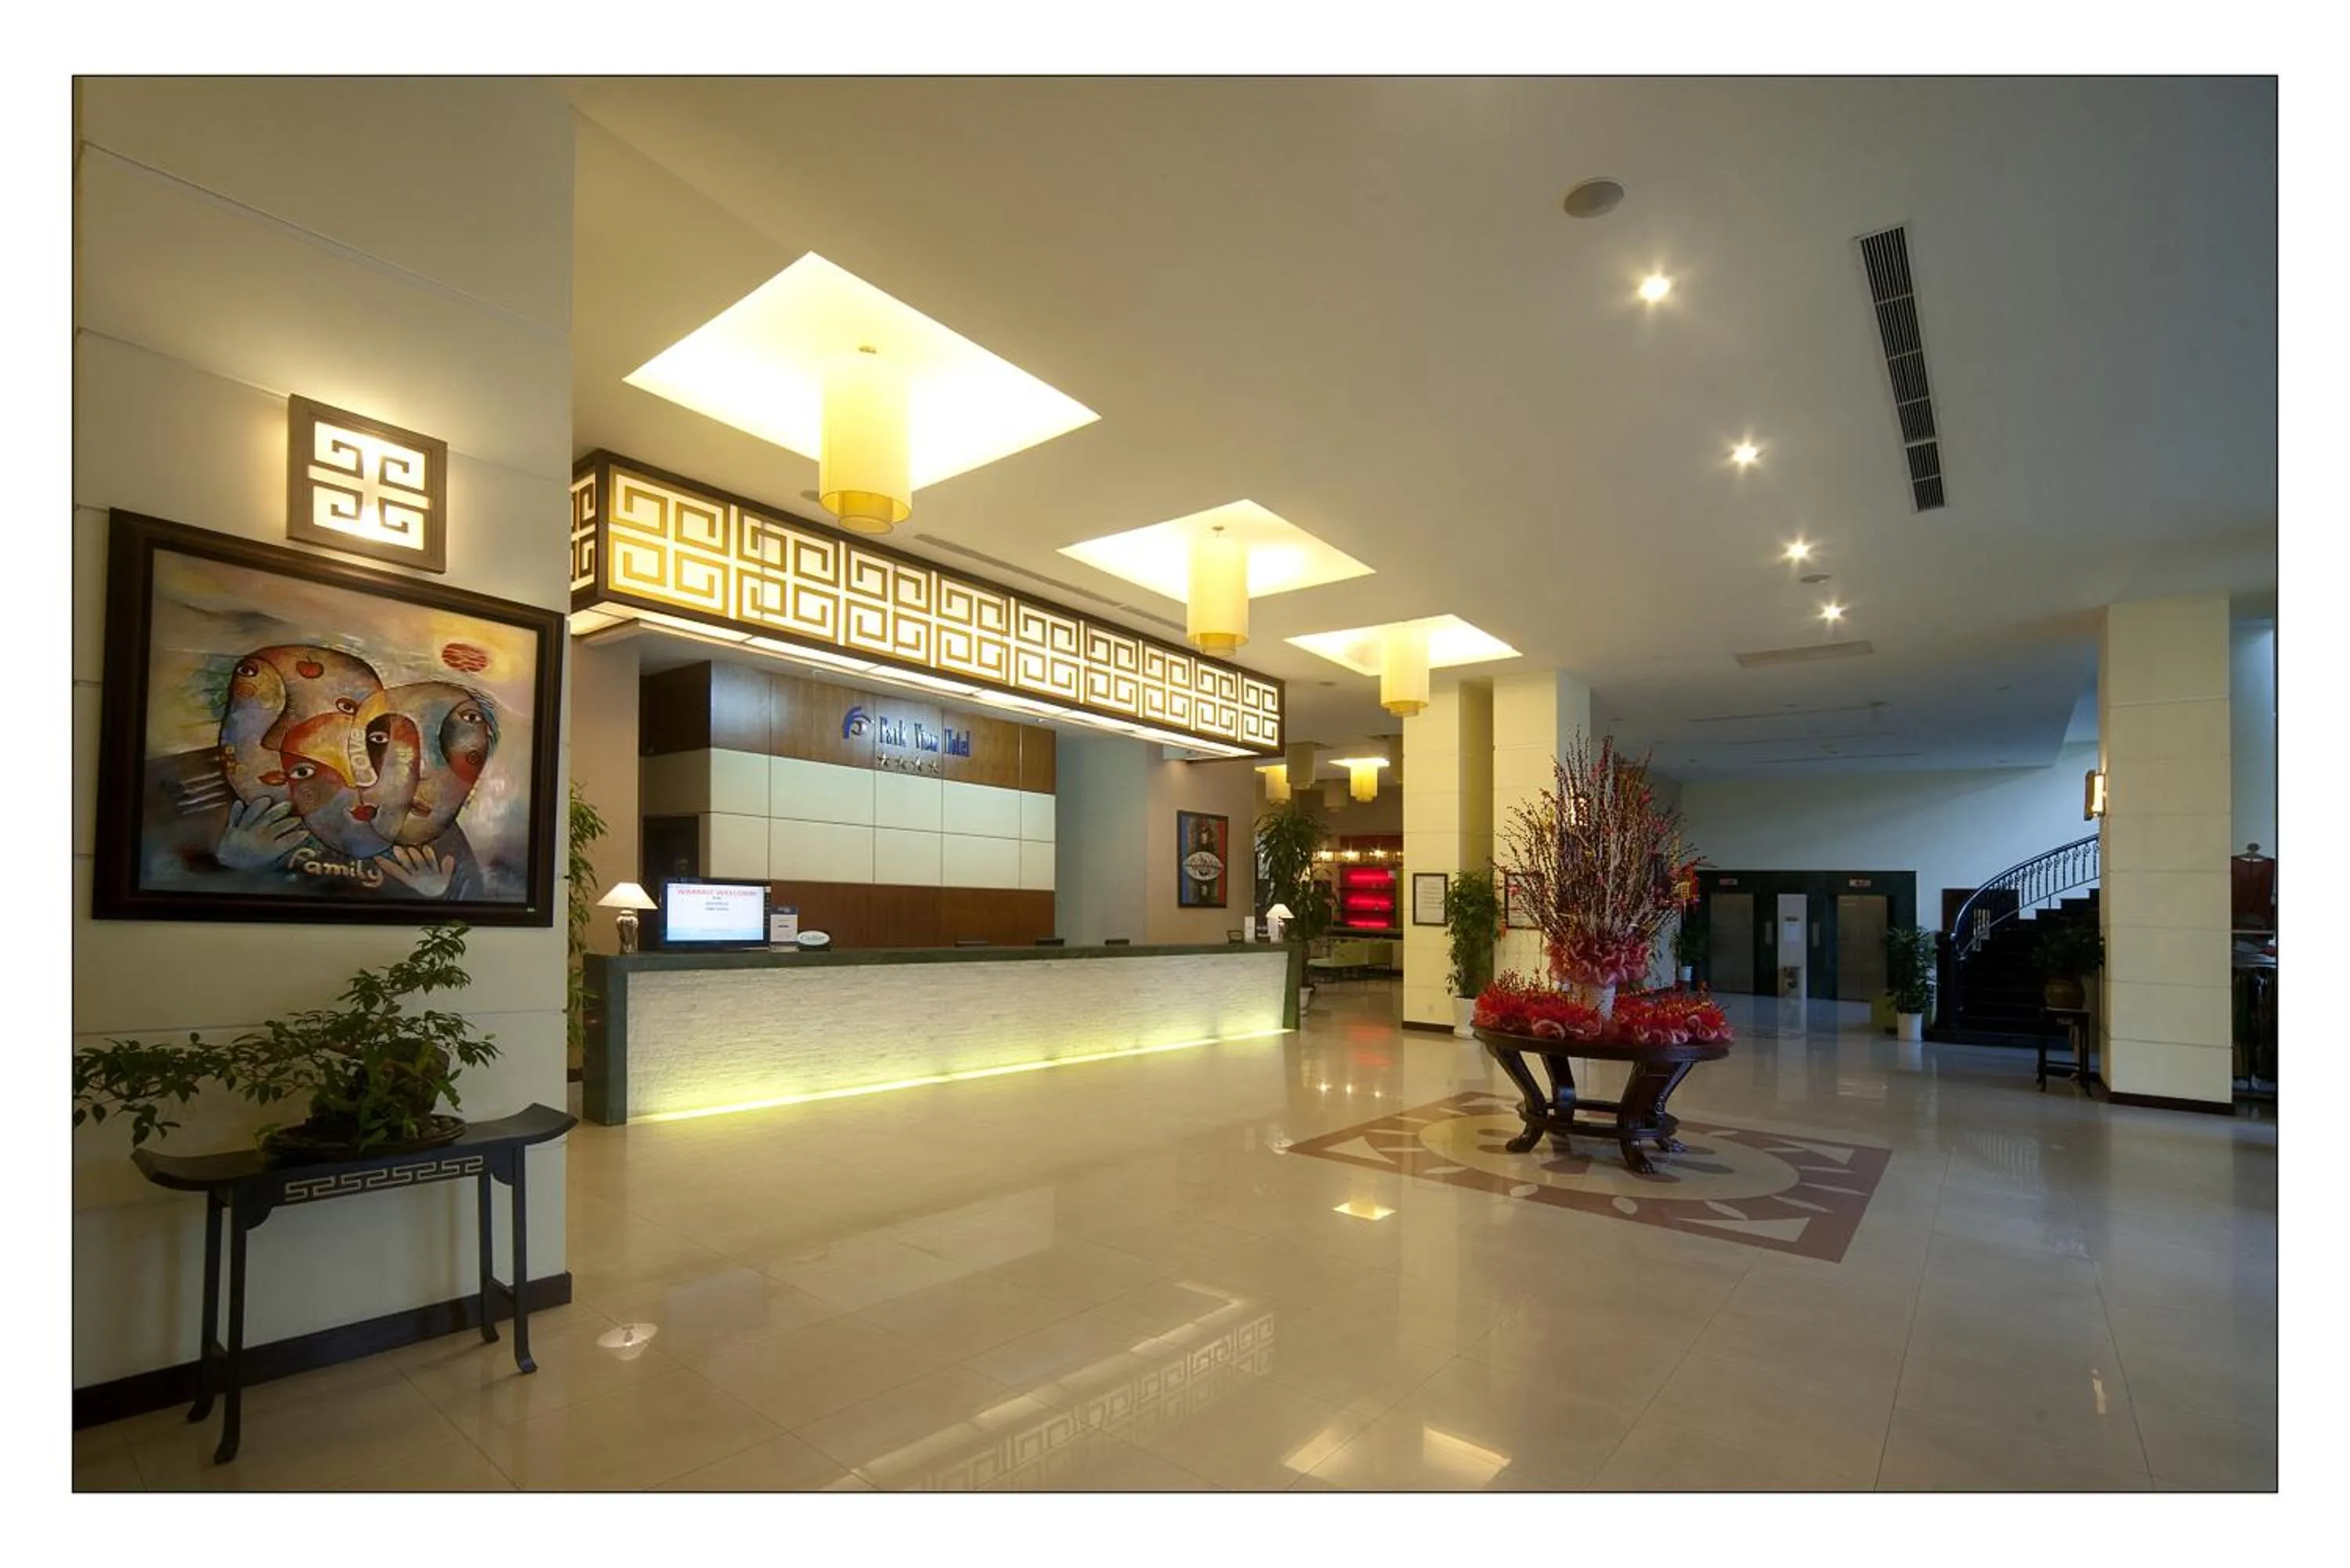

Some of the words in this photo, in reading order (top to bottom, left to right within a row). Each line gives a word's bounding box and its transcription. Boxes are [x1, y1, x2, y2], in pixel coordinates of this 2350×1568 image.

[879, 716, 907, 747] Park
[943, 727, 970, 757] Hotel
[288, 847, 384, 887] Family
